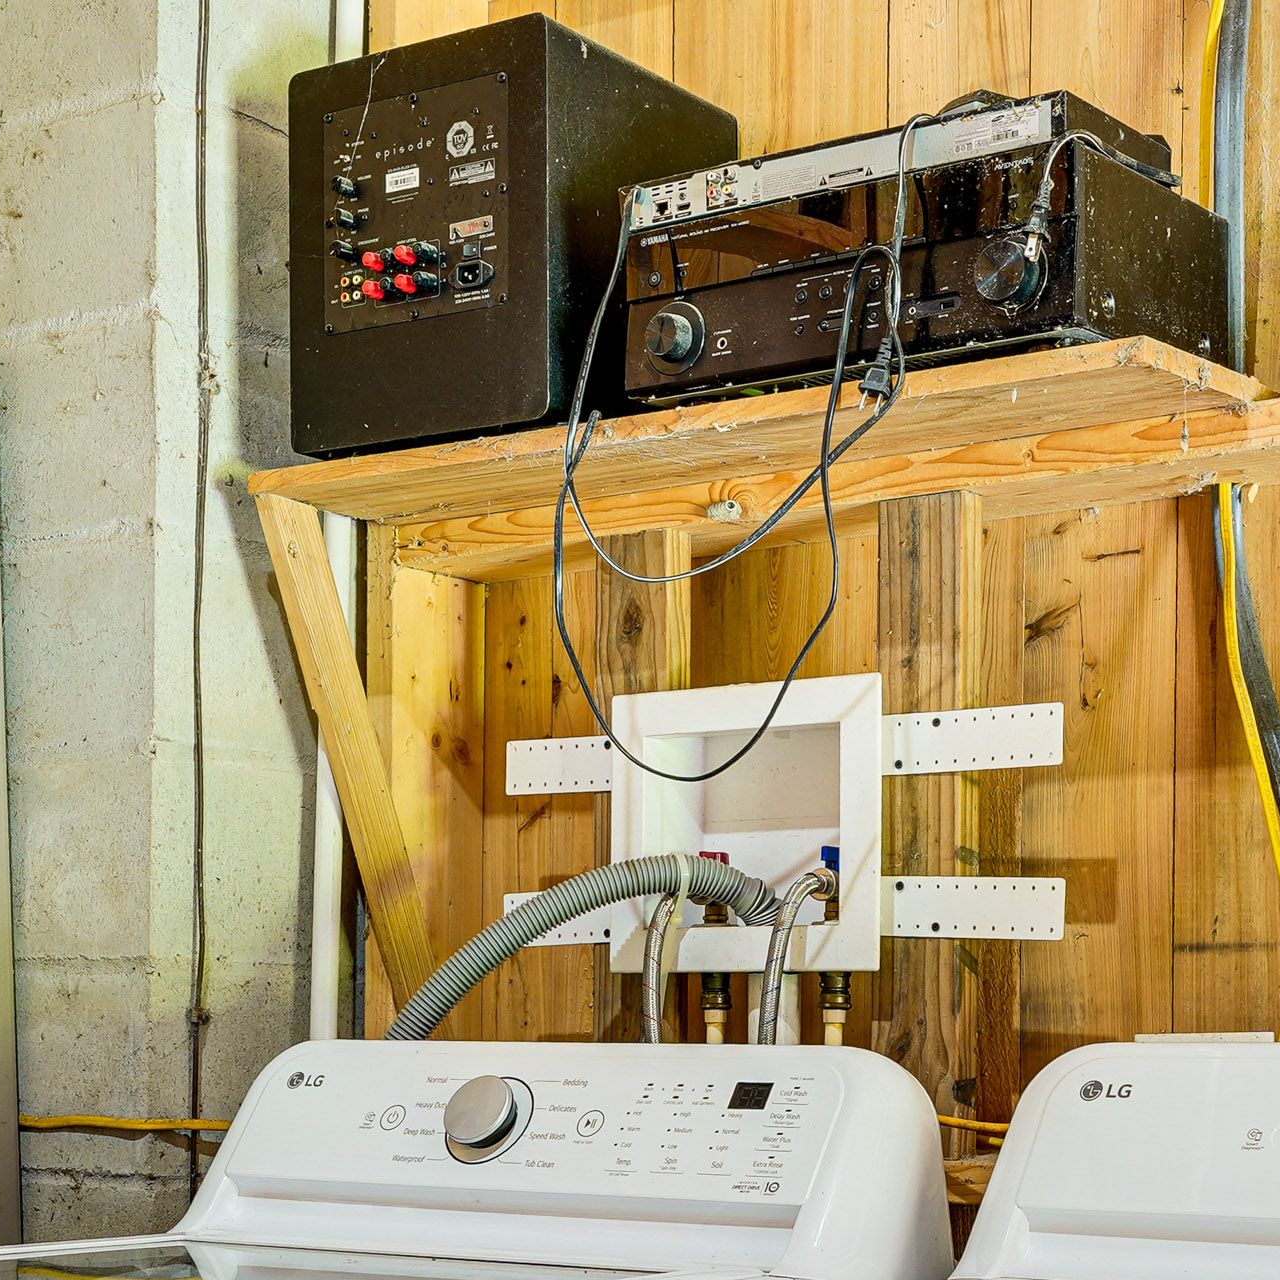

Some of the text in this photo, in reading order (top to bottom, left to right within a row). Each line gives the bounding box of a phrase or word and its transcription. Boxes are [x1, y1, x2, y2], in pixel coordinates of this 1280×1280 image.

[375, 137, 433, 162] episode
[647, 233, 669, 246] YAMAHA
[304, 1074, 325, 1087] LG
[563, 1079, 589, 1088] Bedding
[1106, 1083, 1133, 1099] LG
[415, 1101, 432, 1110] Heavy
[548, 1105, 577, 1113] Delicates
[728, 1112, 743, 1120] Heavy
[770, 1113, 785, 1121] Delay
[403, 1128, 436, 1136] Deep Wash
[528, 1131, 566, 1140] Speed Wash
[779, 1136, 792, 1144] Plus
[716, 1144, 729, 1152] Light
[392, 1155, 426, 1163] Waterproof
[664, 1157, 678, 1165] Spin
[711, 1161, 723, 1169] Soil
[524, 1160, 555, 1168] Tub Clean
[768, 1161, 783, 1169] Rinse
